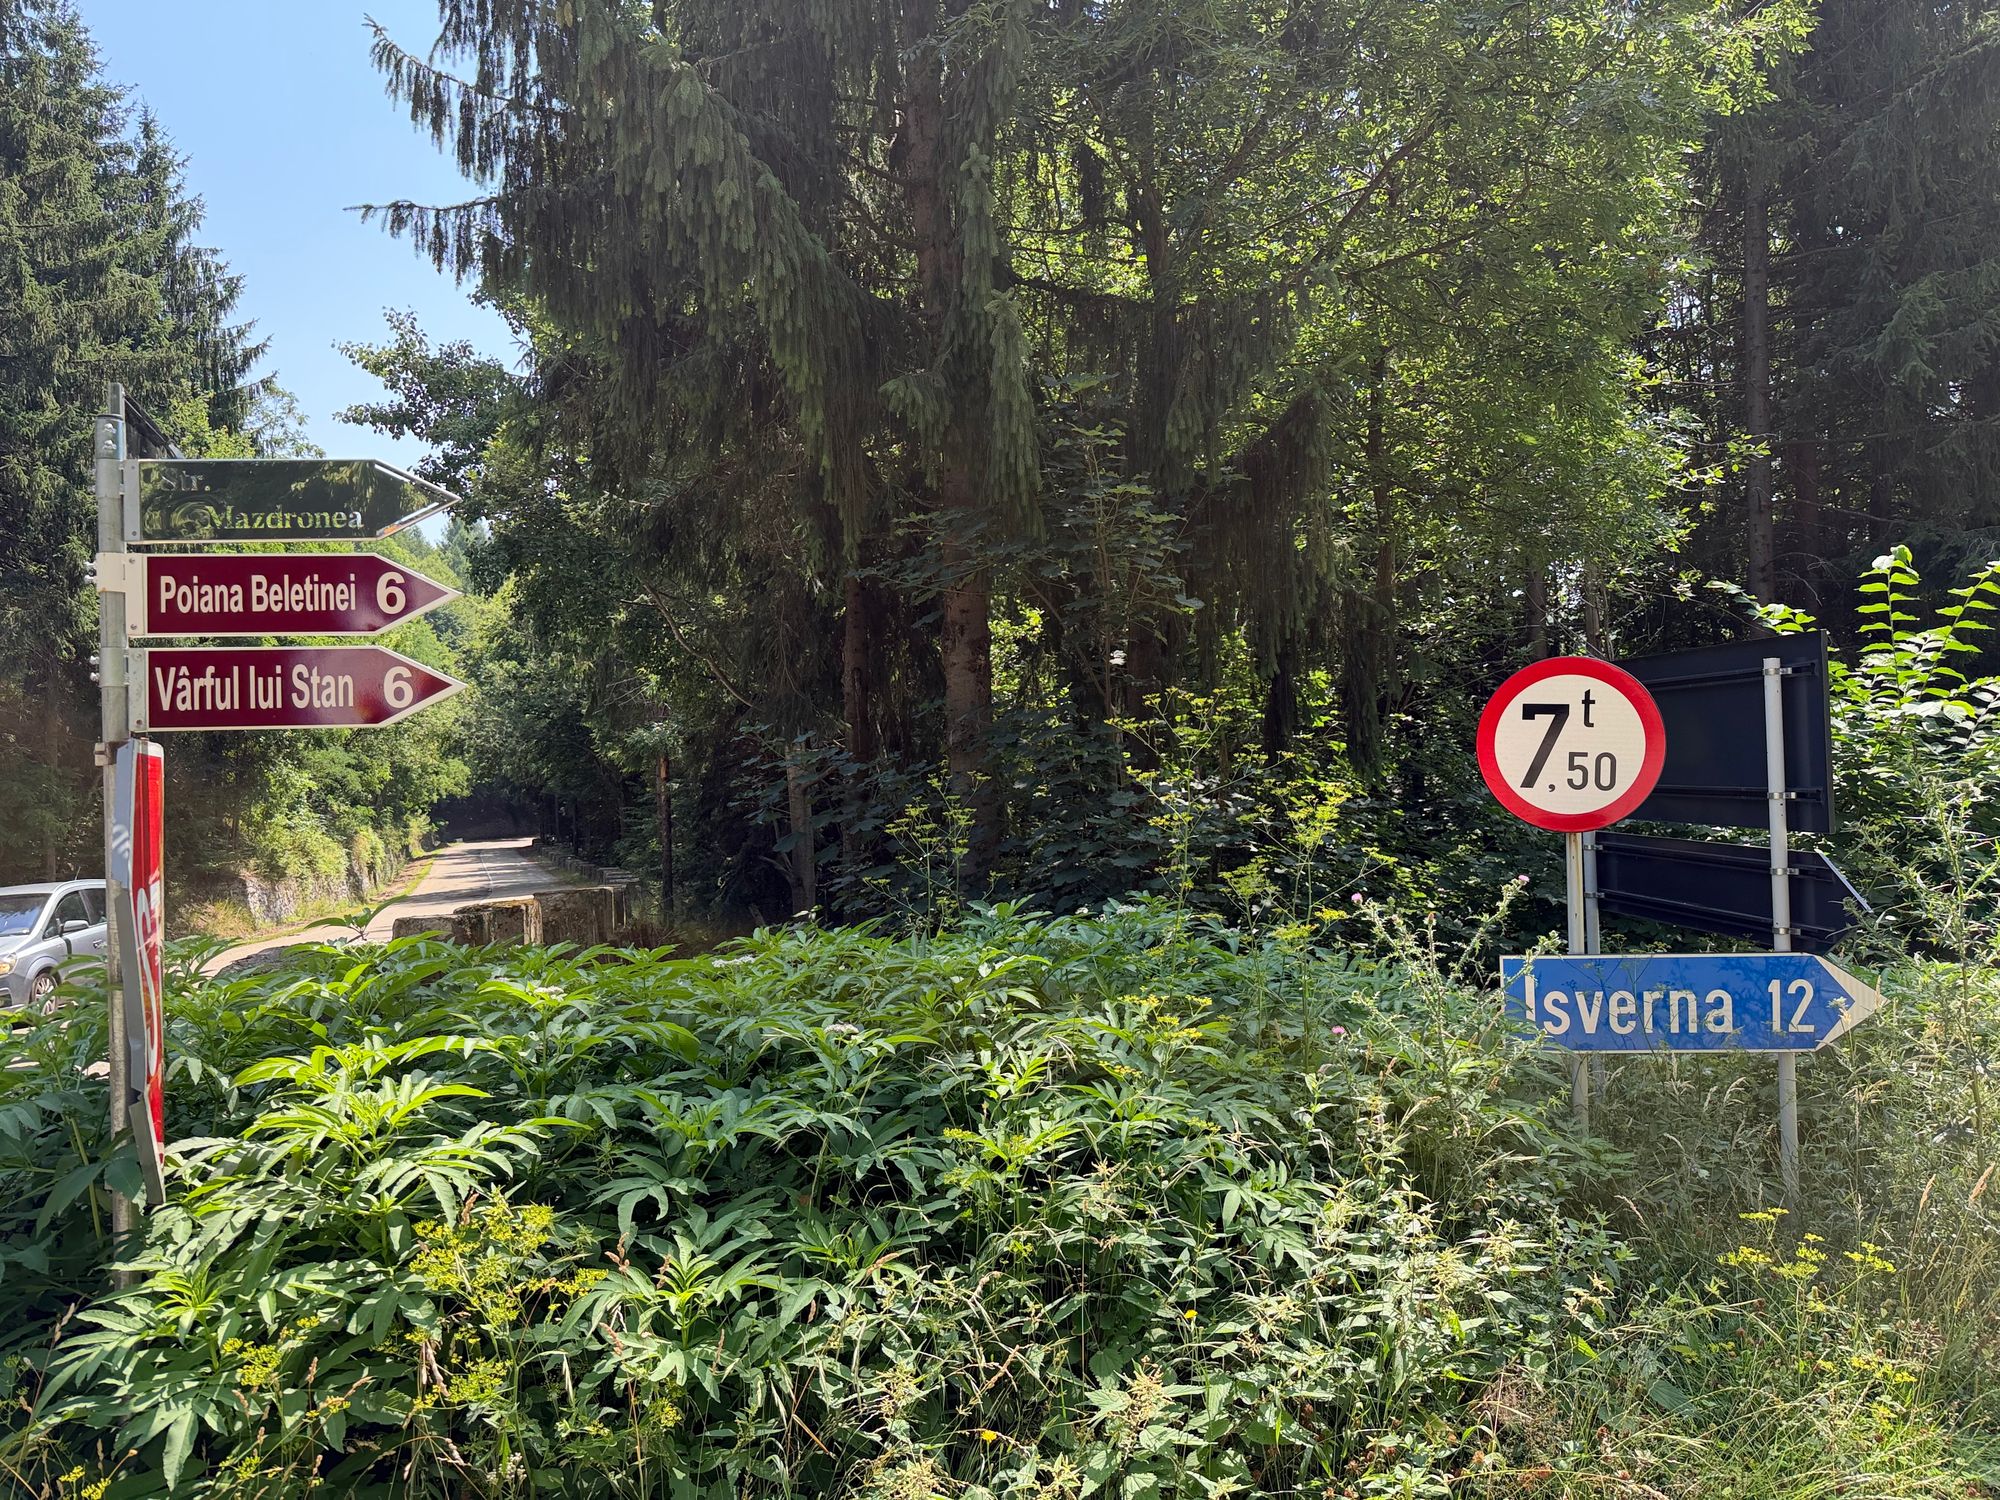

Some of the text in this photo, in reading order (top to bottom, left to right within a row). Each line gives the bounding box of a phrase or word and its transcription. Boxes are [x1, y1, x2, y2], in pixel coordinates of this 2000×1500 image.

[160, 467, 211, 492] Str.
[206, 505, 365, 530] Mazdronea
[159, 571, 406, 615] Poiana Beletinei 6
[154, 663, 414, 711] Vârful lui Stan 6
[1524, 973, 1815, 1035] Isverna 12
